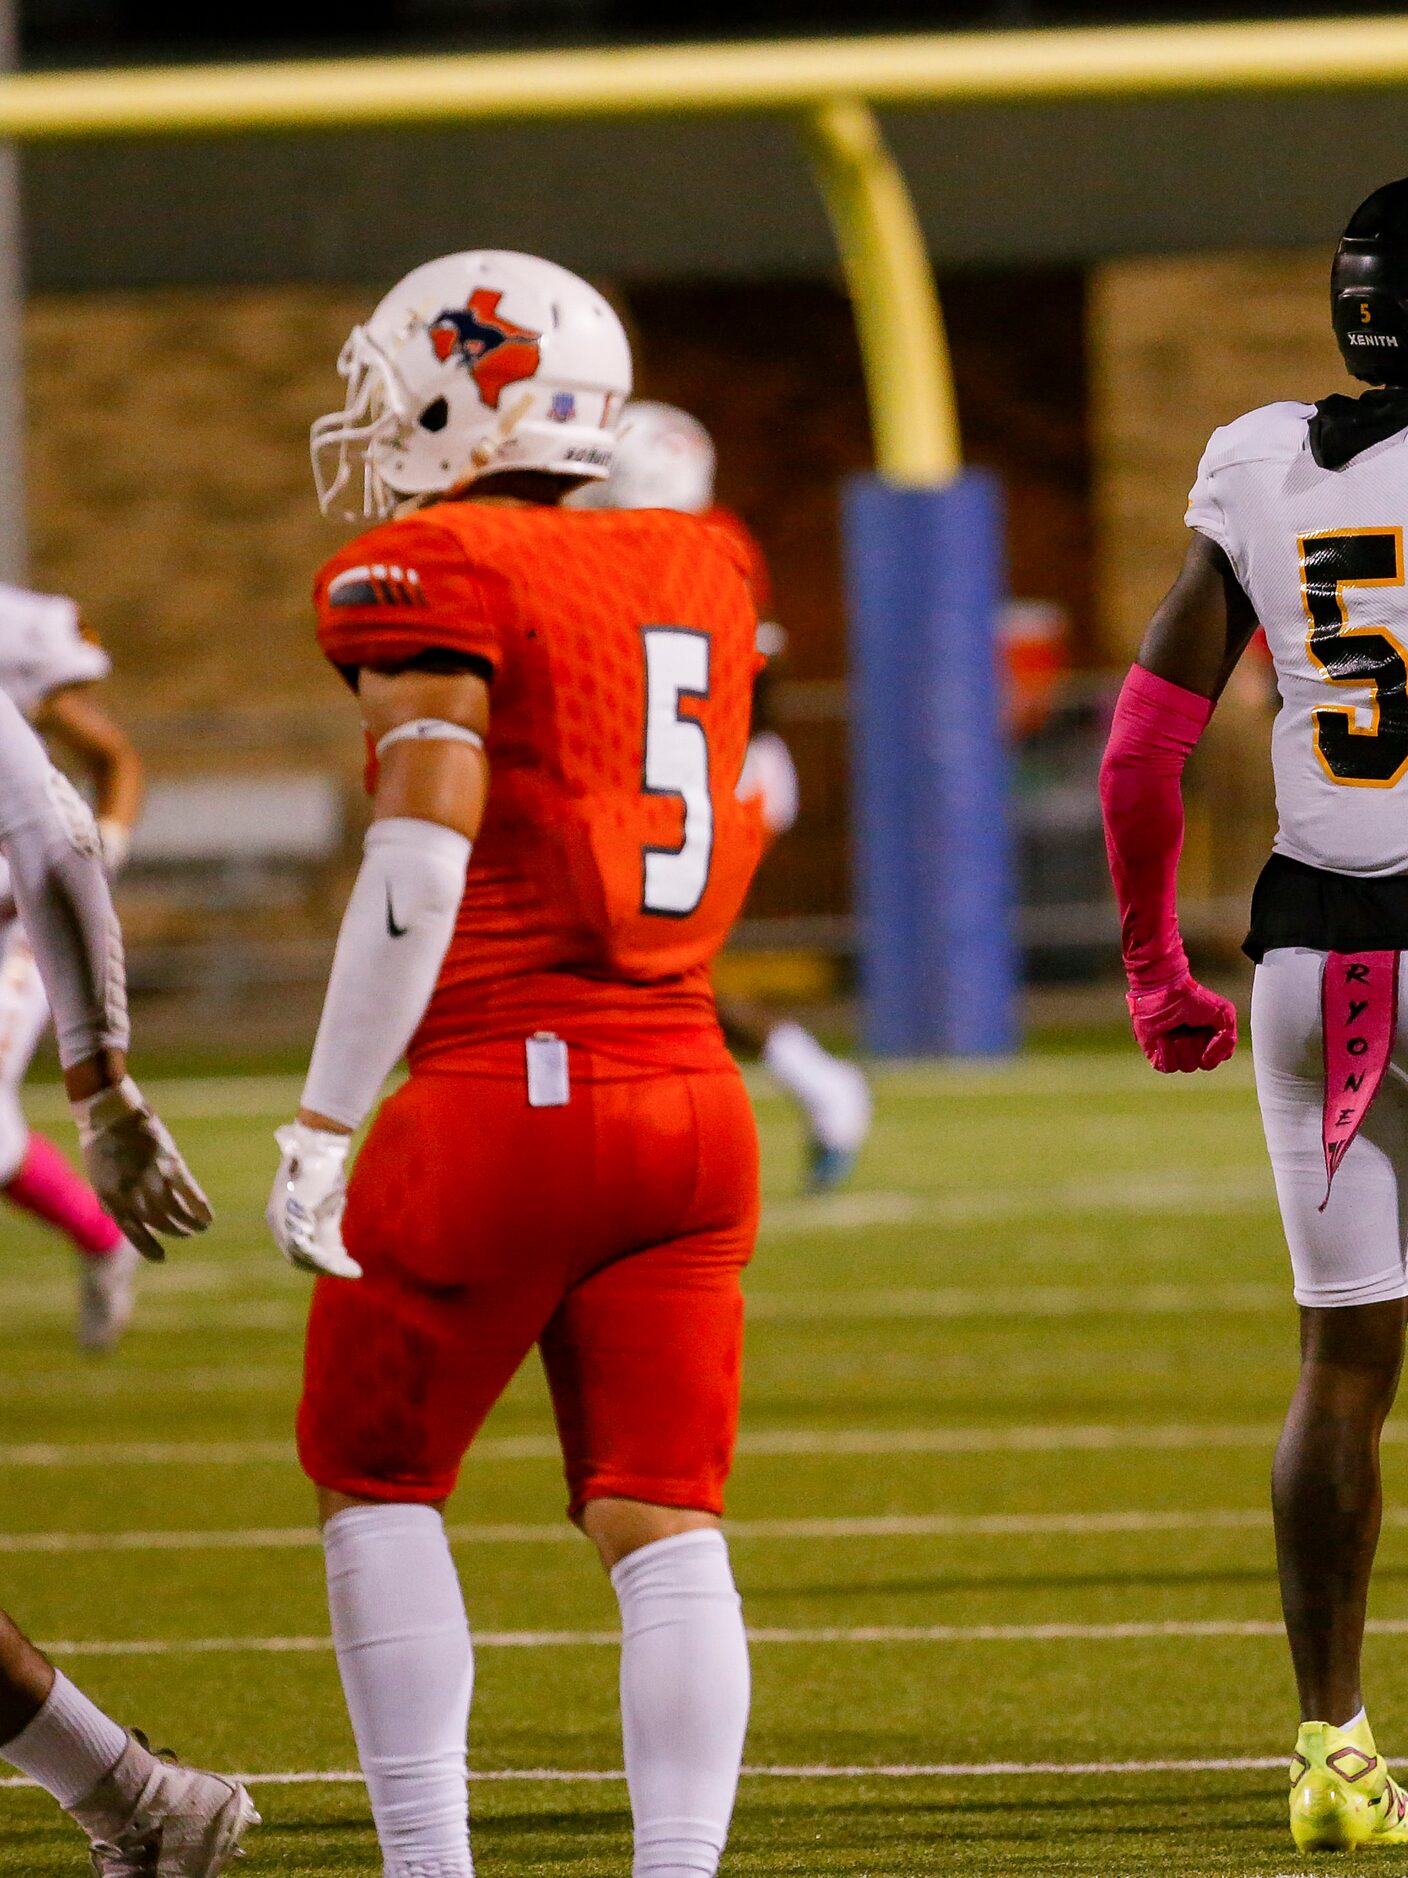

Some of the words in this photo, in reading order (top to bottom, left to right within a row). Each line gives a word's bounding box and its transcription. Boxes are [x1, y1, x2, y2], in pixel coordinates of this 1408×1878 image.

[1360, 303, 1371, 324] 5
[1347, 334, 1398, 347] XENITH
[641, 624, 713, 917] 5
